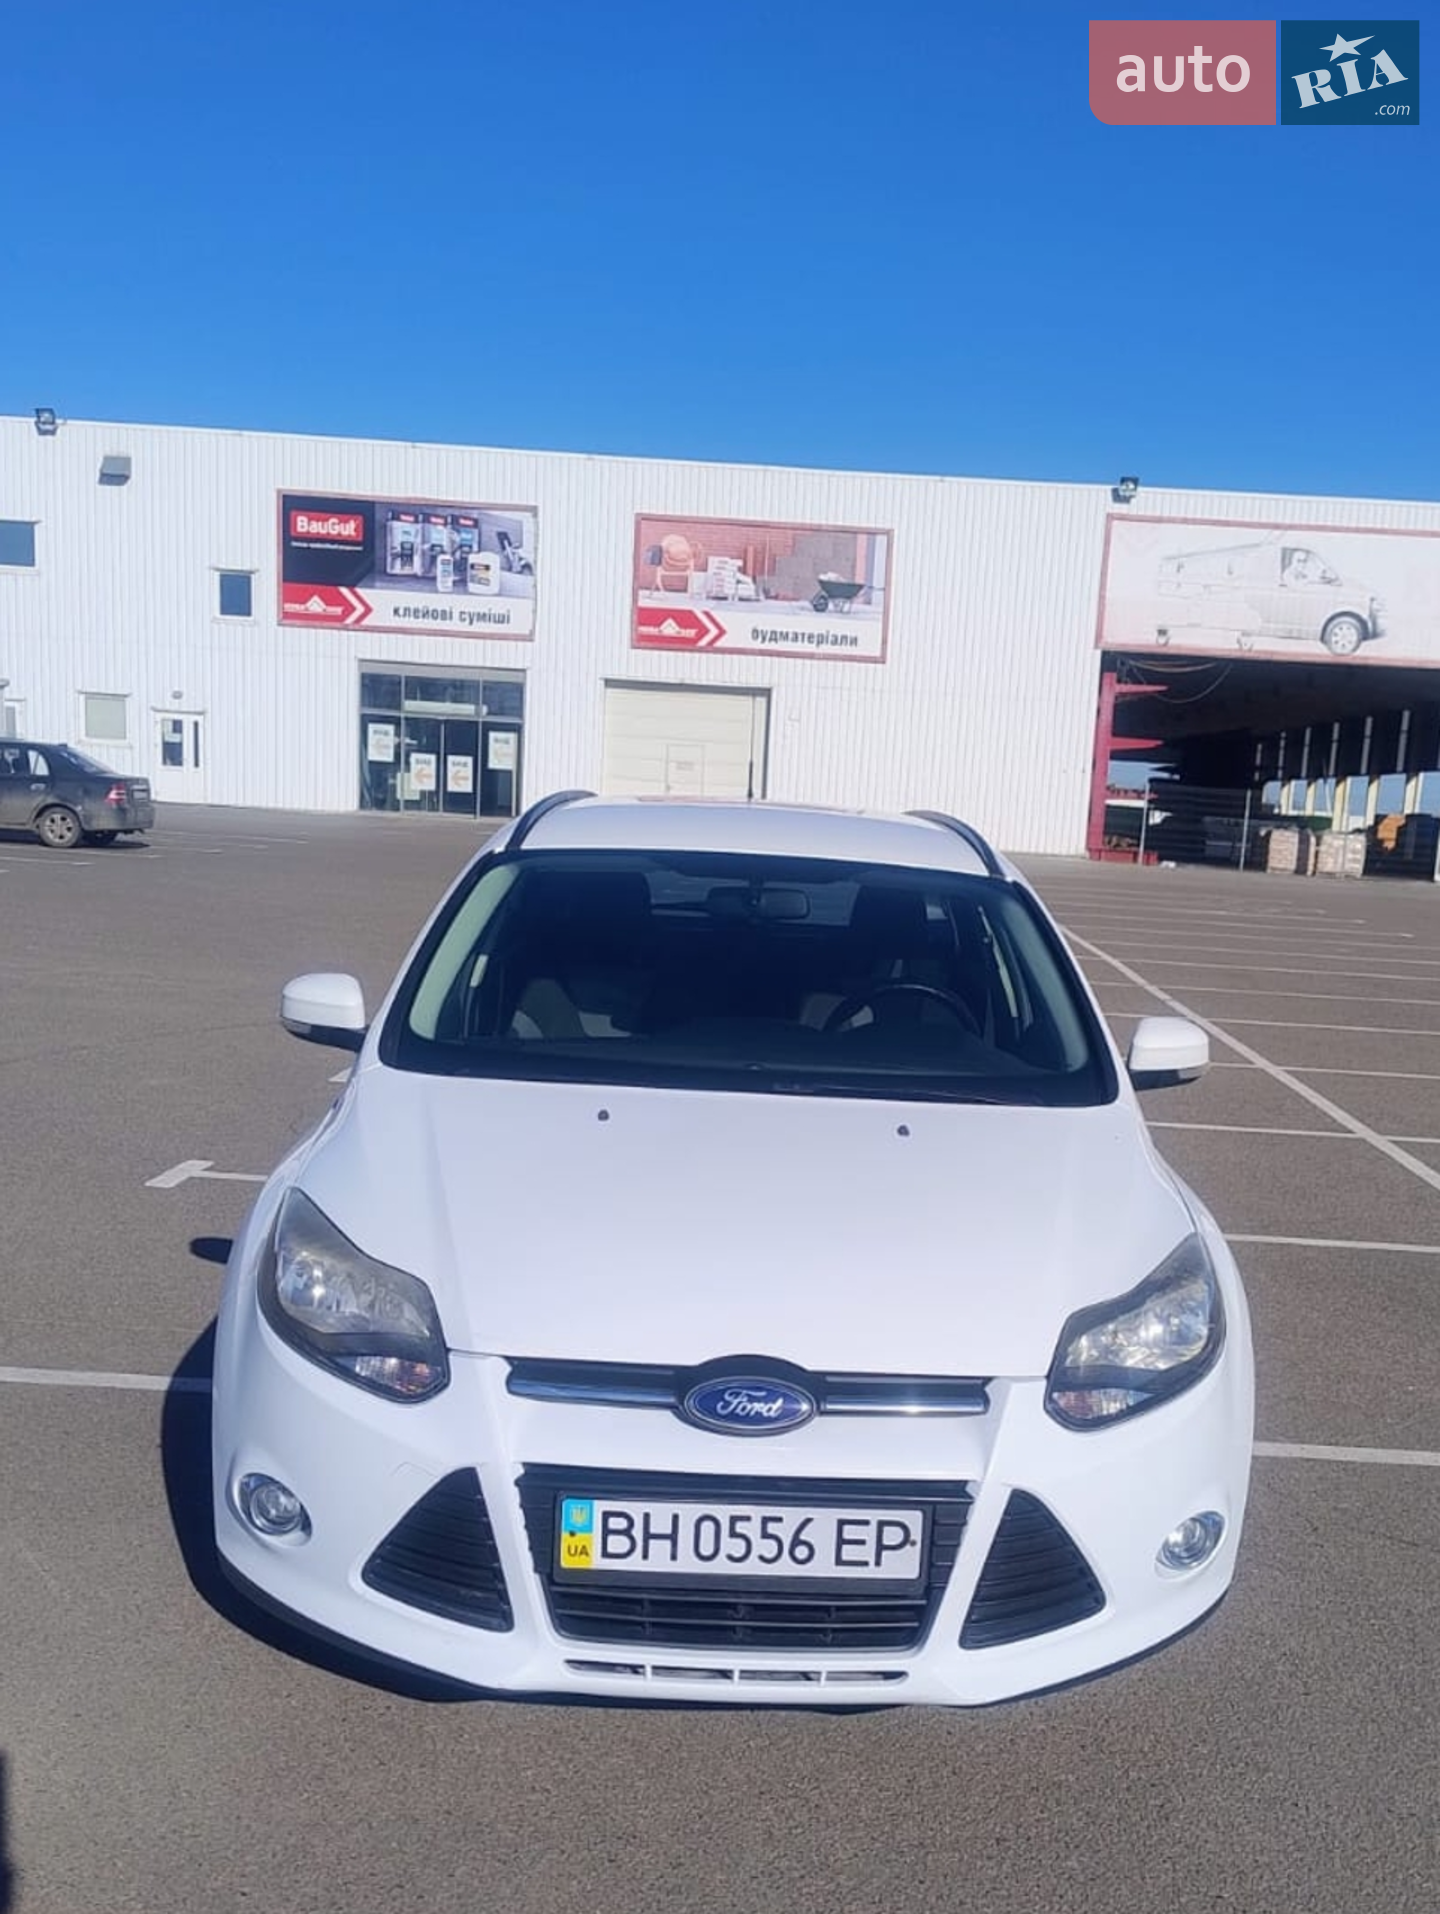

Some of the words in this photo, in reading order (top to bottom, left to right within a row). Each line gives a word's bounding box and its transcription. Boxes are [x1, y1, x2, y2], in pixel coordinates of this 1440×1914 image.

[296, 515, 357, 536] BauGut
[393, 604, 454, 621] клейові
[459, 606, 511, 627] суміші
[751, 626, 858, 649] будматеріали
[715, 1388, 785, 1418] Ford
[600, 1509, 680, 1562] BH
[692, 1513, 816, 1566] 0556
[834, 1517, 912, 1568] EP
[566, 1544, 590, 1559] UA
